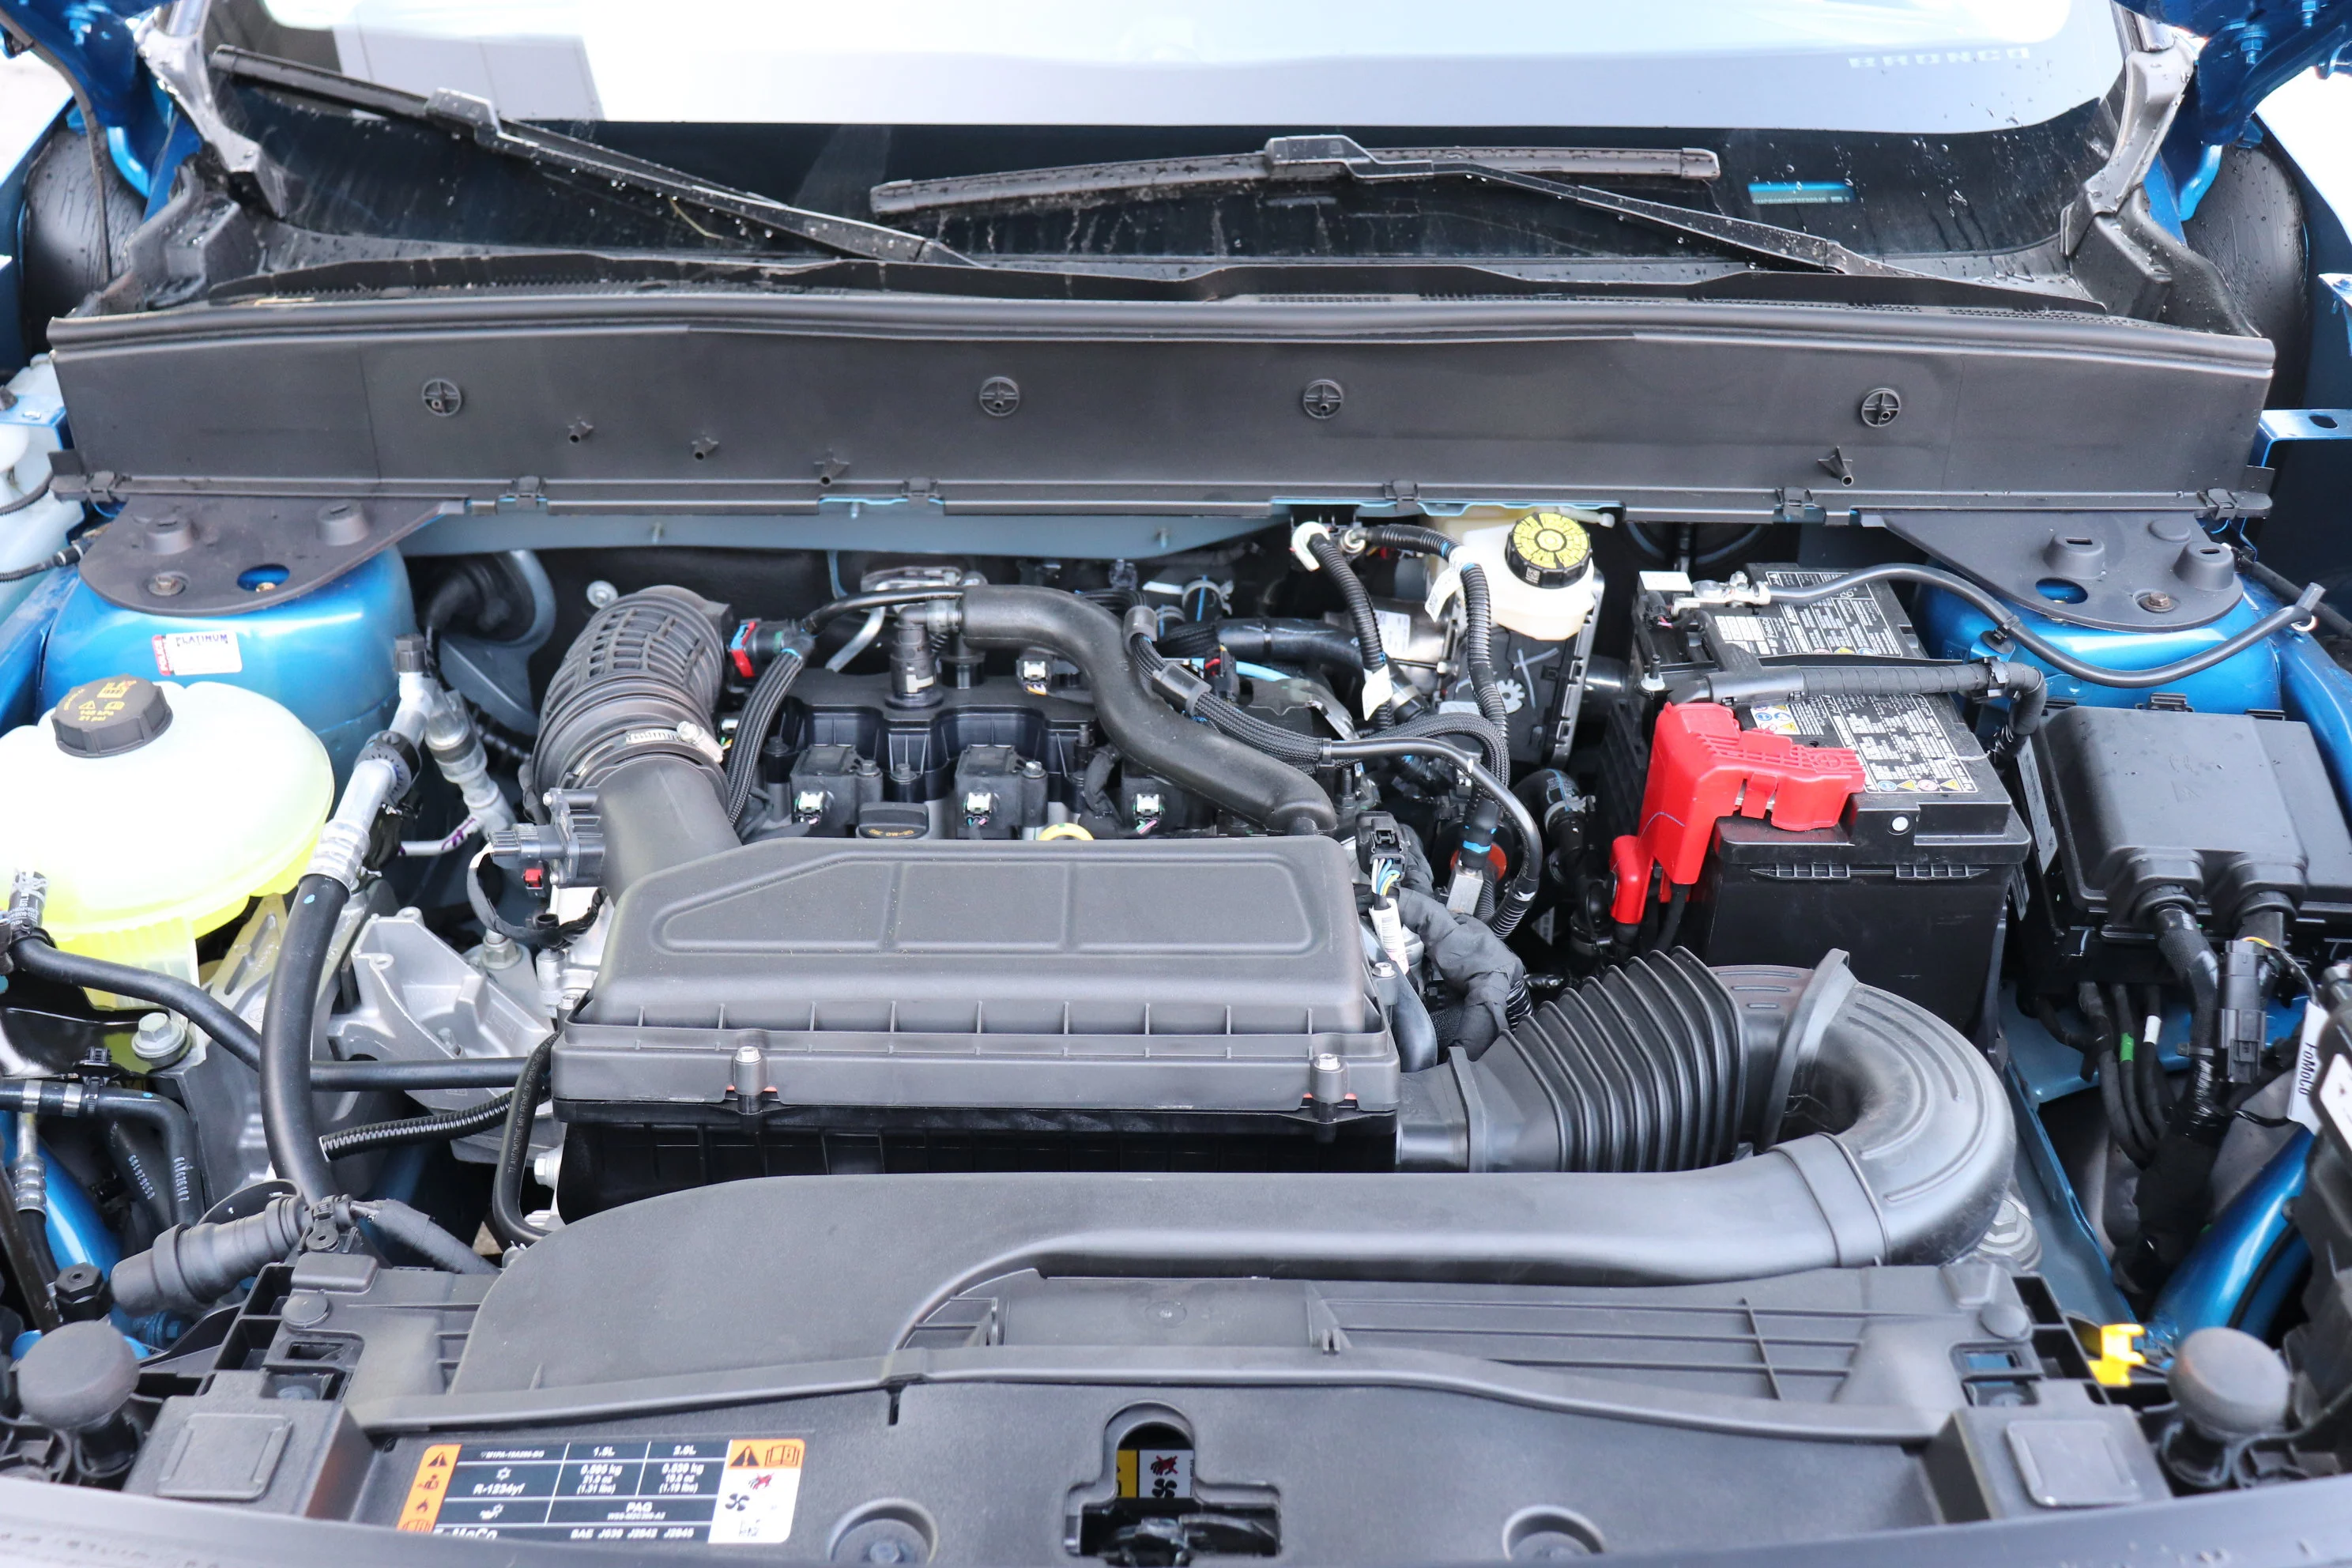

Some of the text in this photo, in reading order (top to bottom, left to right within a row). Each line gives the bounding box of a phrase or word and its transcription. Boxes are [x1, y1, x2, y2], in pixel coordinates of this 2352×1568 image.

[1848, 47, 2030, 69] BRONCO
[2298, 1042, 2318, 1096] FoMoCo
[673, 1445, 696, 1457] 2.0L
[608, 1464, 623, 1477] kg
[690, 1463, 704, 1476] kg
[473, 1483, 526, 1496] R-1234yf
[626, 1502, 653, 1513] PAG
[570, 1528, 594, 1540] SAE
